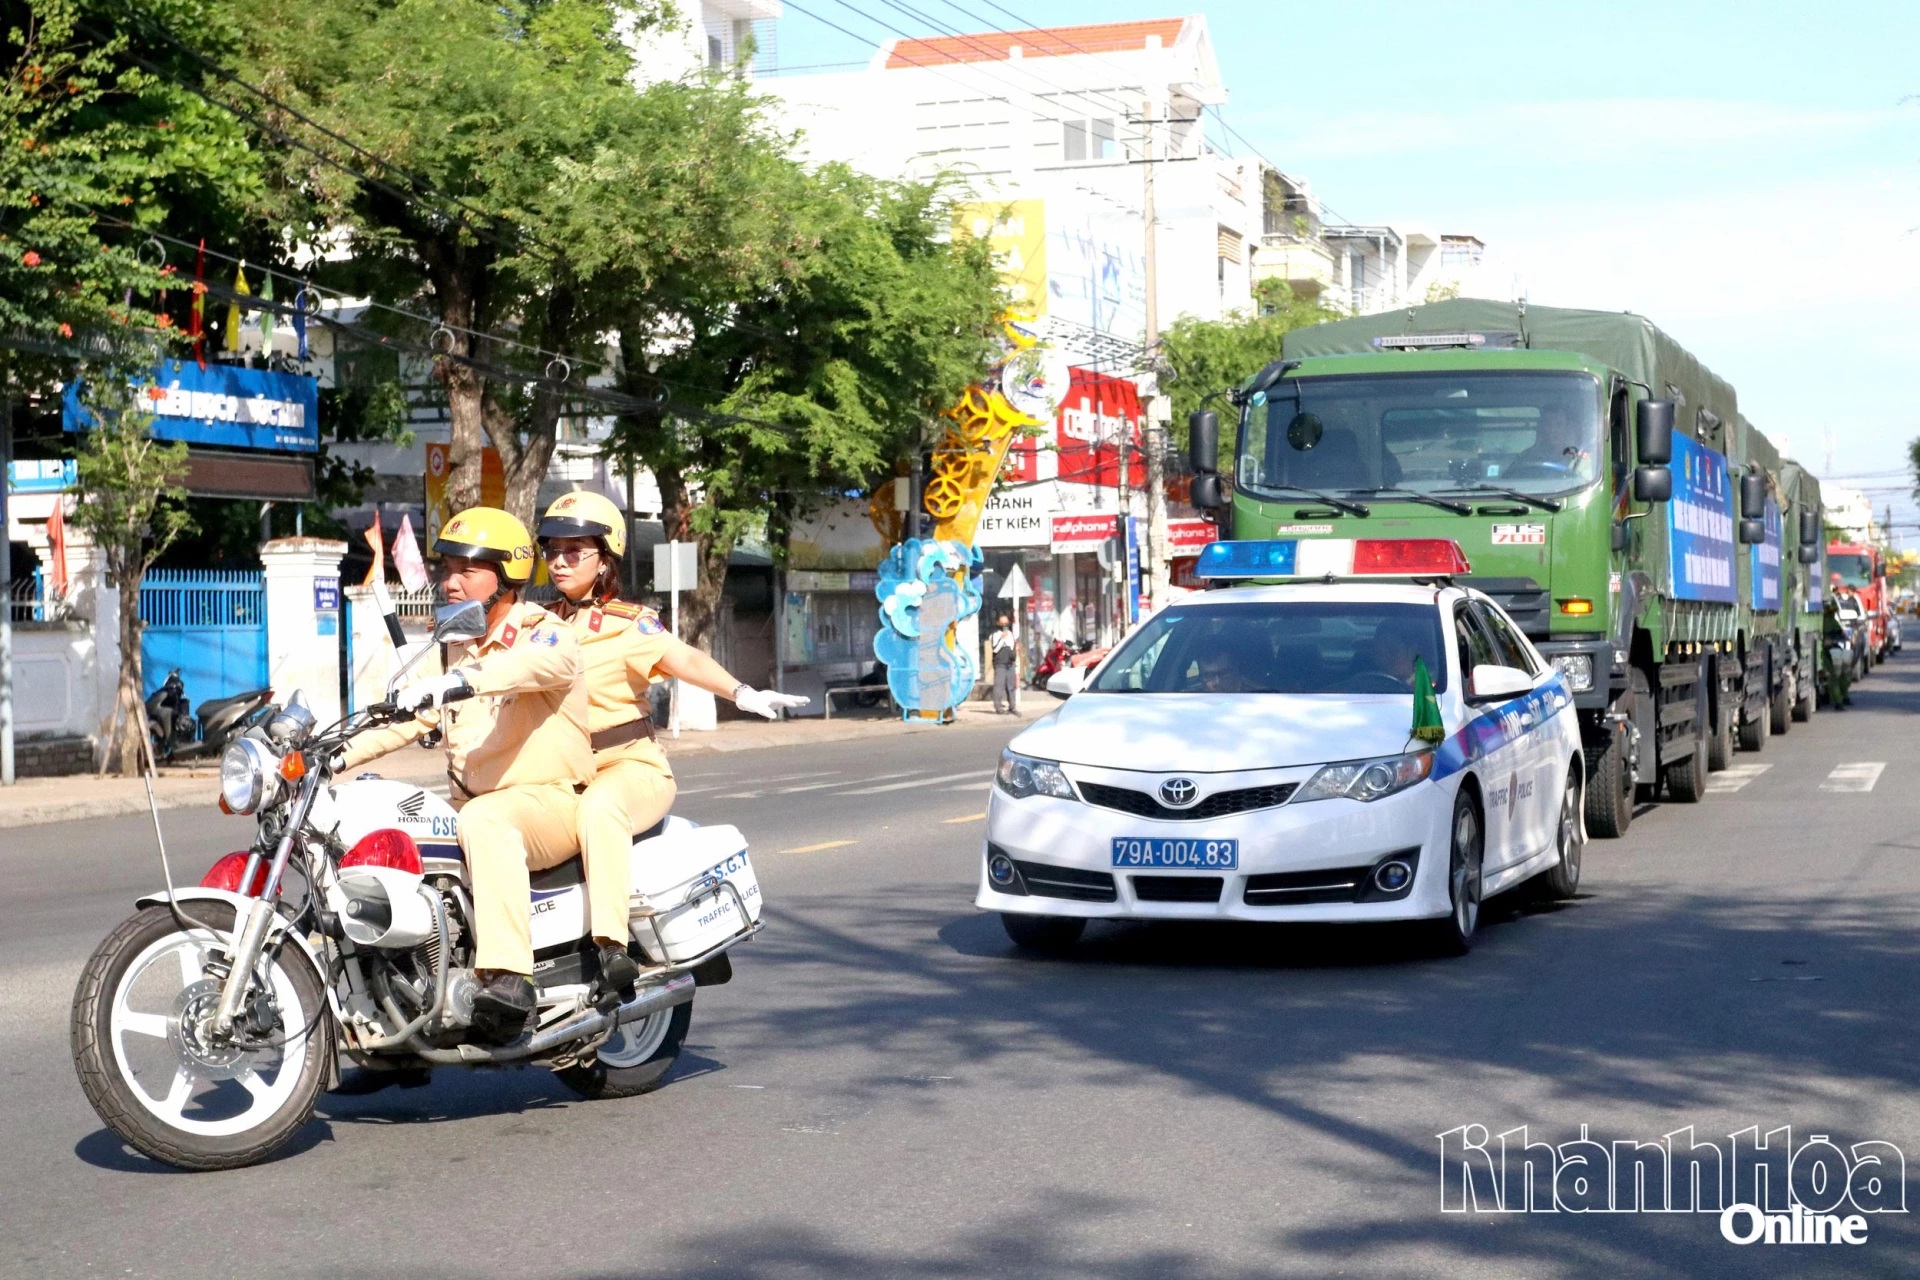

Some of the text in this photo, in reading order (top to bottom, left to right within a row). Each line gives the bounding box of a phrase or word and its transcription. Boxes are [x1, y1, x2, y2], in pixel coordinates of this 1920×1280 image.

[1053, 521, 1108, 535] cellphone
[1489, 781, 1533, 808] TRAFFIC POLICE
[397, 816, 432, 824] HONDA
[1116, 840, 1232, 866] 79A-004.83
[698, 885, 759, 927] TRAFFIC PLICE
